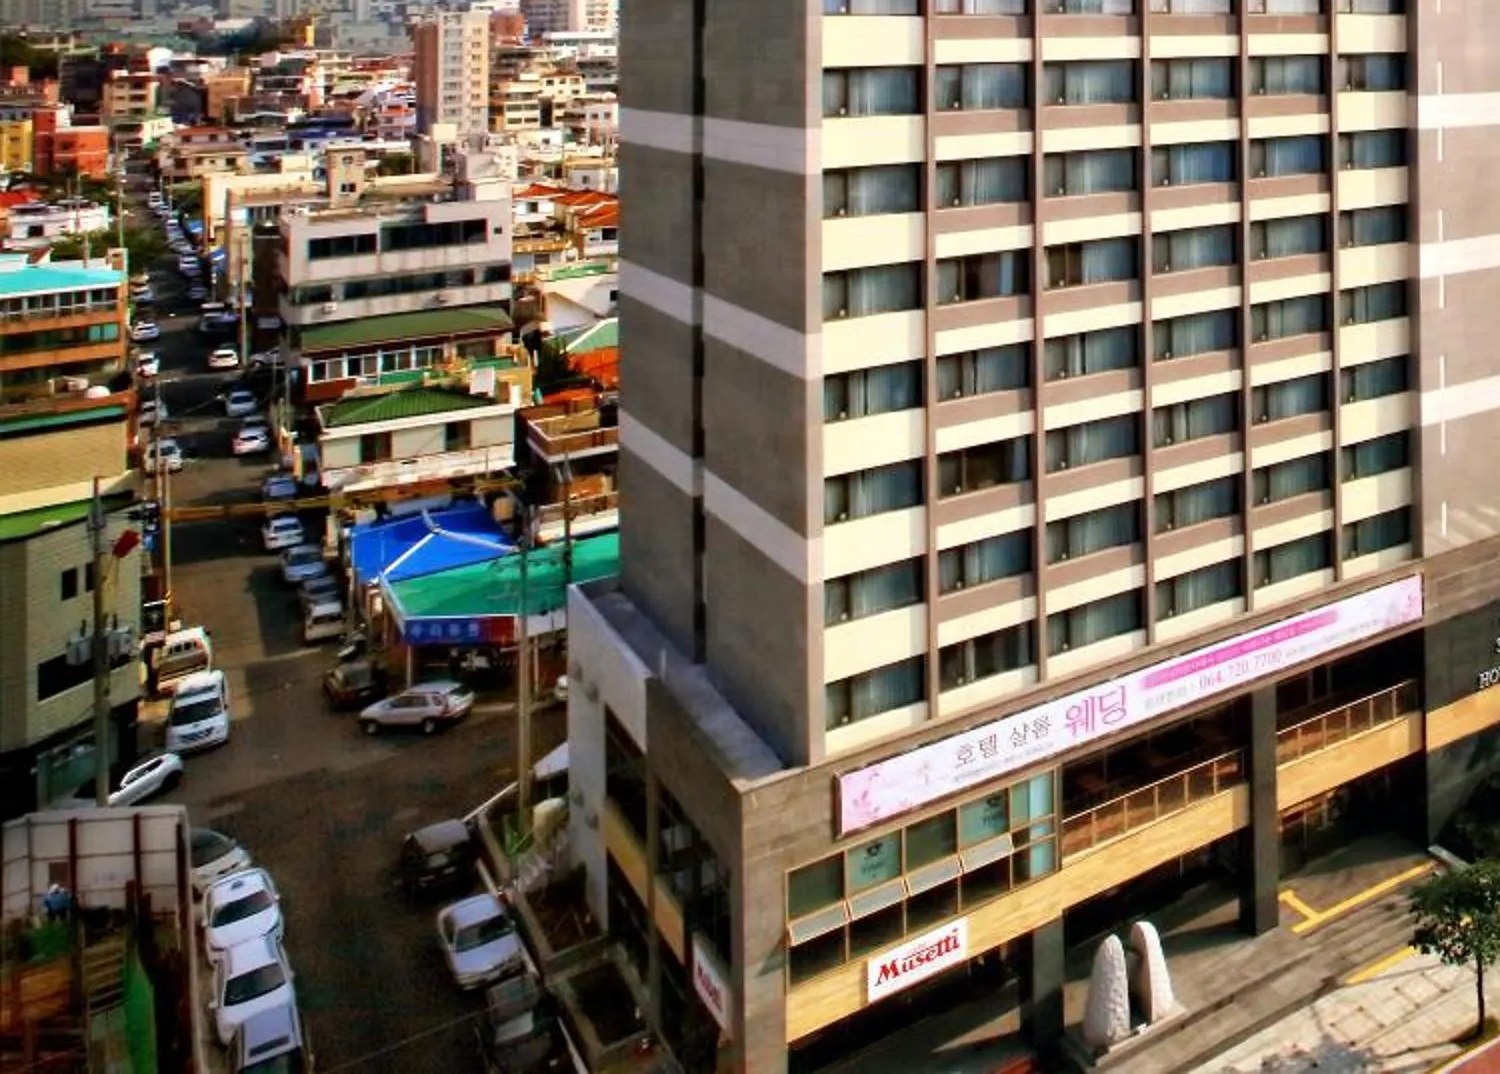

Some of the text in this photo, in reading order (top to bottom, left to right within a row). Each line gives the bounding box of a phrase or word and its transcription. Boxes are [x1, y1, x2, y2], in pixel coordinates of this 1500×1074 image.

[955, 732, 998, 766] 호텔
[1064, 684, 1129, 738] 웨딩
[874, 927, 961, 987] Musetti
